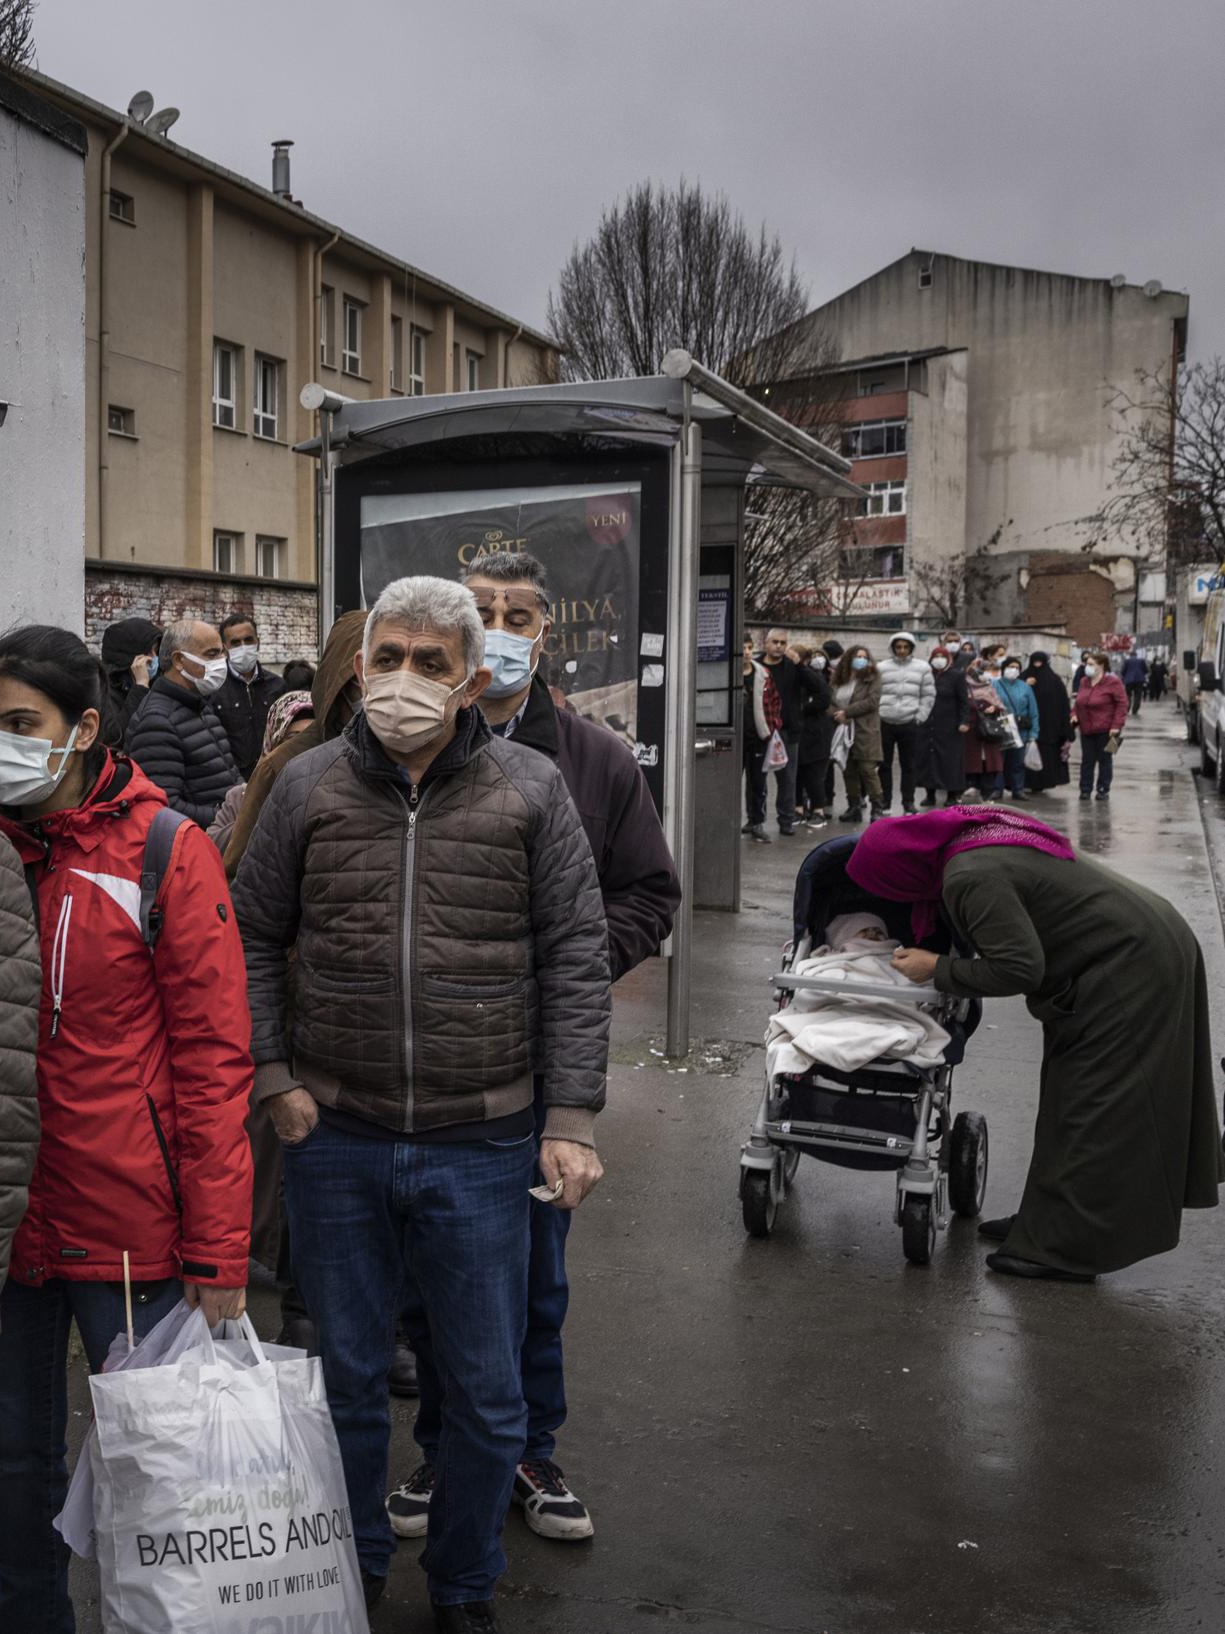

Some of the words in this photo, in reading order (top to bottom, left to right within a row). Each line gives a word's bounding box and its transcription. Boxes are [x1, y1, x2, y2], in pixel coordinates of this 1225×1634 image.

[591, 511, 628, 528] YENİ
[457, 538, 529, 566] CARTE
[546, 594, 622, 625] NİLYA,
[136, 1522, 276, 1567] BARRELS
[218, 1584, 241, 1604] WE
[246, 1581, 264, 1601] DO
[268, 1579, 280, 1598] IT
[284, 1574, 315, 1595] WITH
[317, 1566, 341, 1588] LOVE
